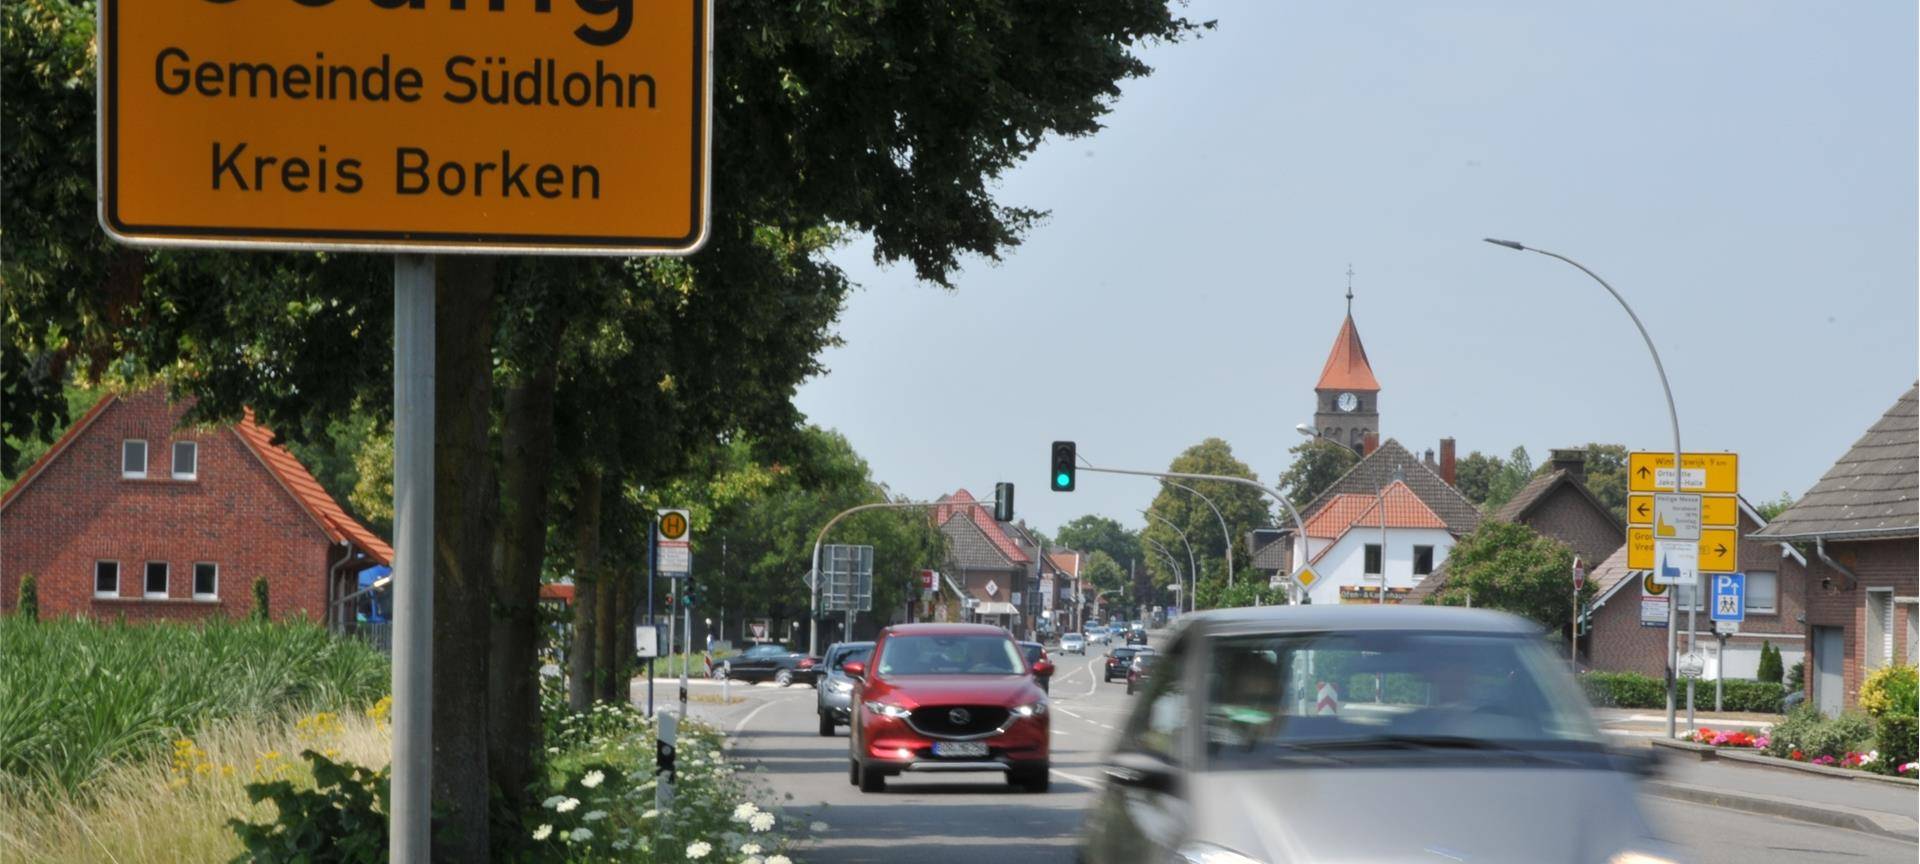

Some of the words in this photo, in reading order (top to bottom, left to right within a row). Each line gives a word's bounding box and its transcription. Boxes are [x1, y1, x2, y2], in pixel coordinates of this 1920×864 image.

[155, 47, 424, 103] Gemeinde
[443, 55, 656, 108] Südlohn
[211, 142, 364, 194] Kreis
[396, 147, 600, 199] Borken
[667, 517, 679, 534] H
[1718, 576, 1732, 594] P
